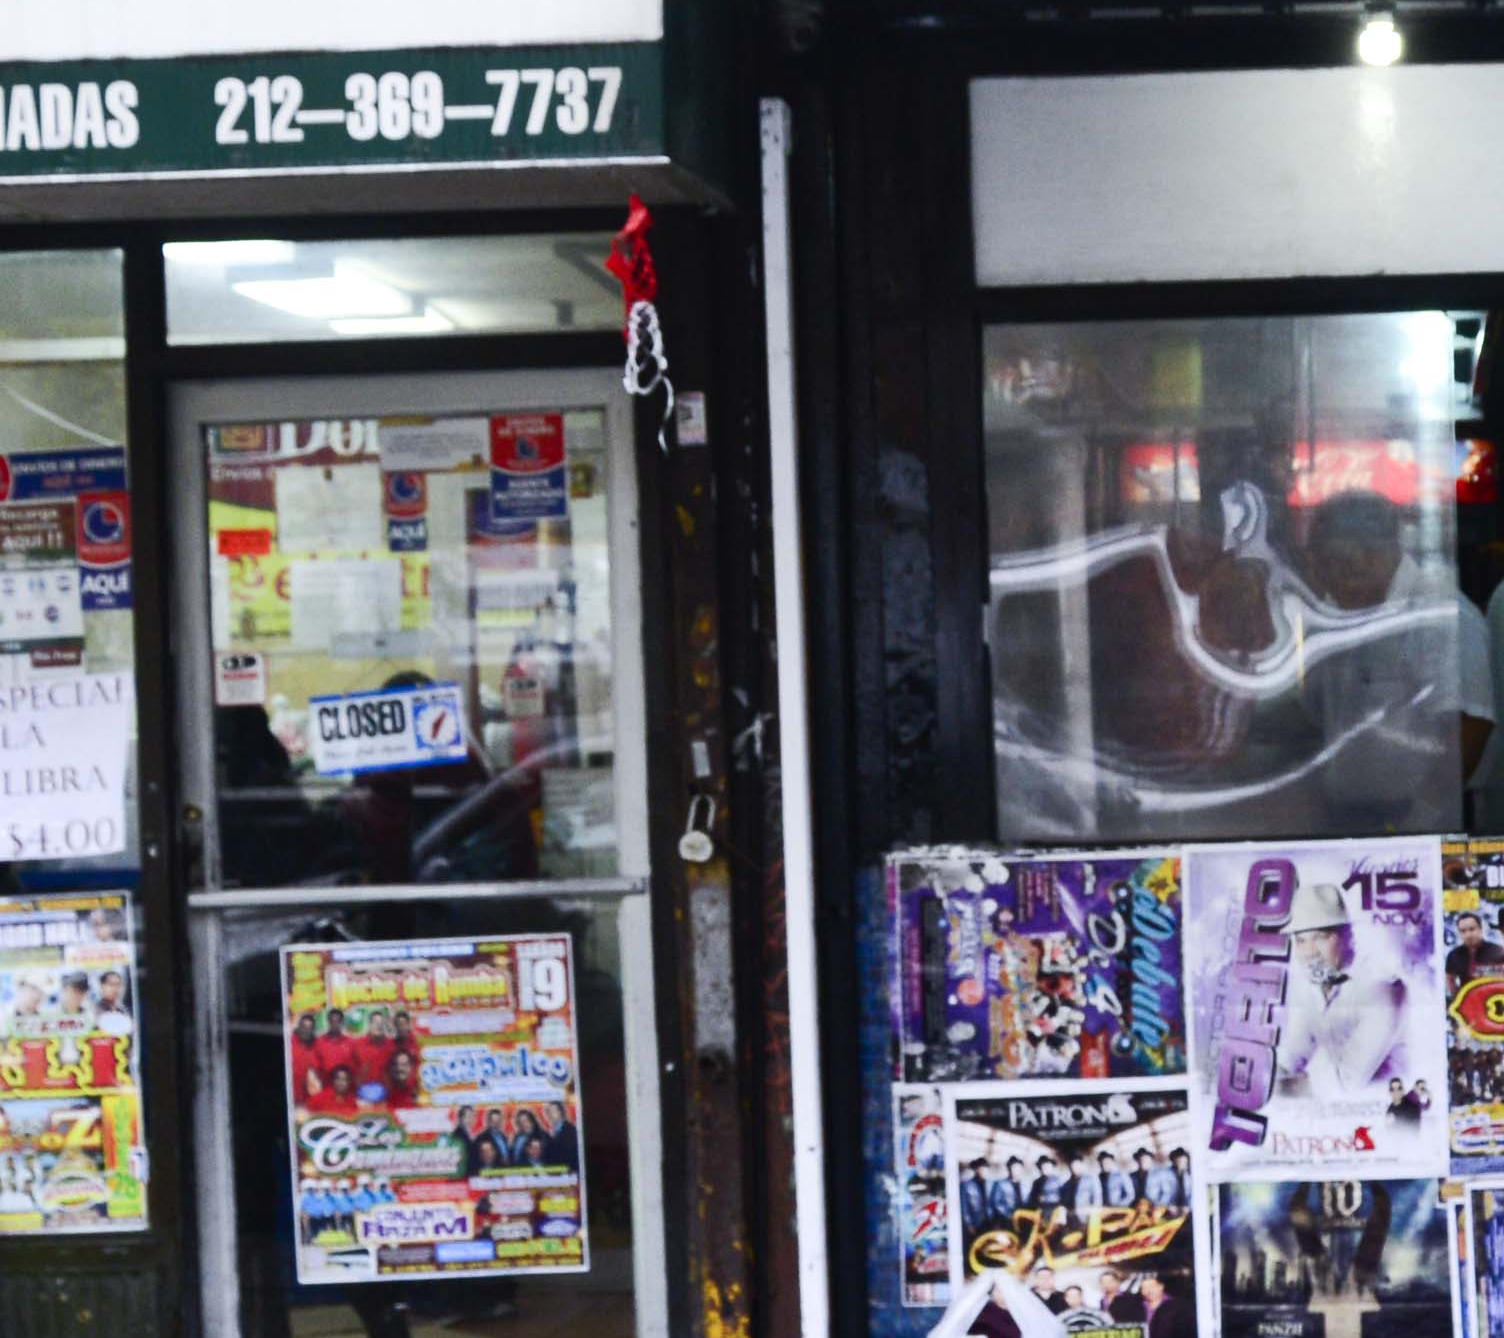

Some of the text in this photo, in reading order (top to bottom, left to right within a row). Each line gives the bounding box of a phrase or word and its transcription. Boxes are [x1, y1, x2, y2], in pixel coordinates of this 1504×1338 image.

[1, 722, 47, 749] LA
[317, 699, 407, 742] CLOSED
[5, 766, 109, 796] LIBRA
[8, 818, 117, 856] $4.00
[1342, 871, 1422, 911] 15
